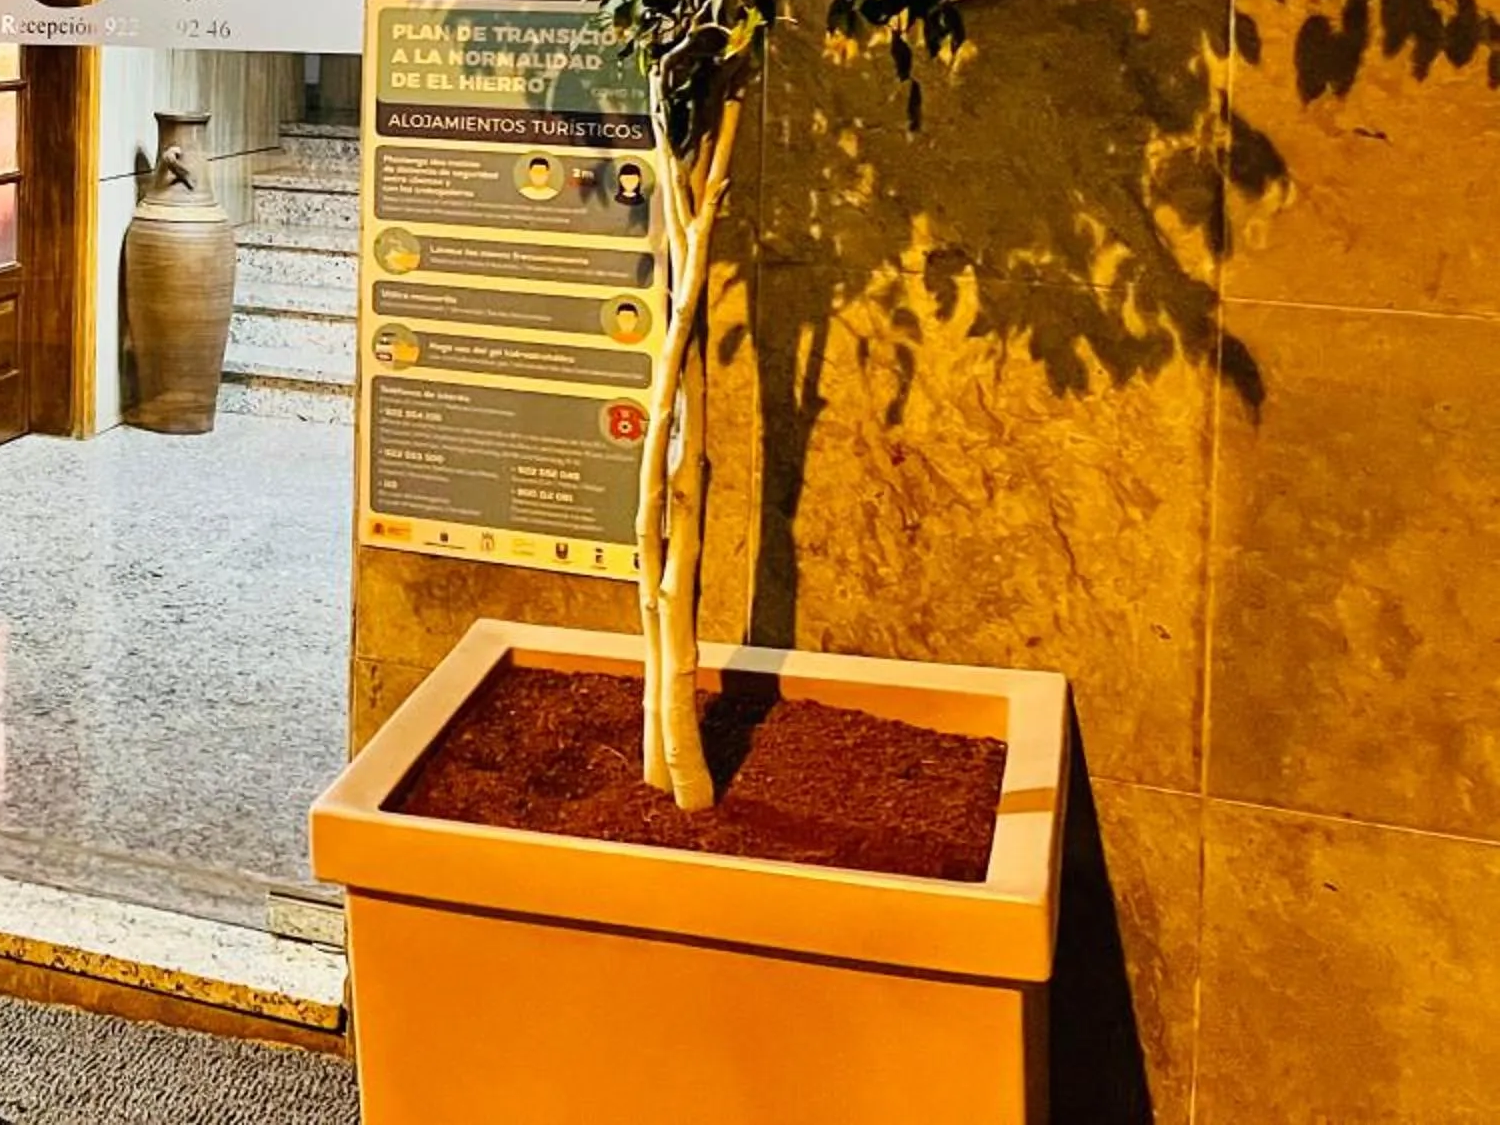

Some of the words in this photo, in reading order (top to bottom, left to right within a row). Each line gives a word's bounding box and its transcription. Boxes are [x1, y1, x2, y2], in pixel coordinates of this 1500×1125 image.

[206, 19, 232, 39] 46
[391, 23, 450, 43] PLAN
[456, 25, 486, 43] DE
[391, 48, 408, 64] A
[414, 49, 443, 66] LA
[448, 51, 603, 70] NORMALIDAD
[391, 72, 421, 89] DE
[427, 73, 453, 91] EL
[459, 75, 544, 94] HIERRO
[388, 114, 527, 135] ALOJAMIENTOS
